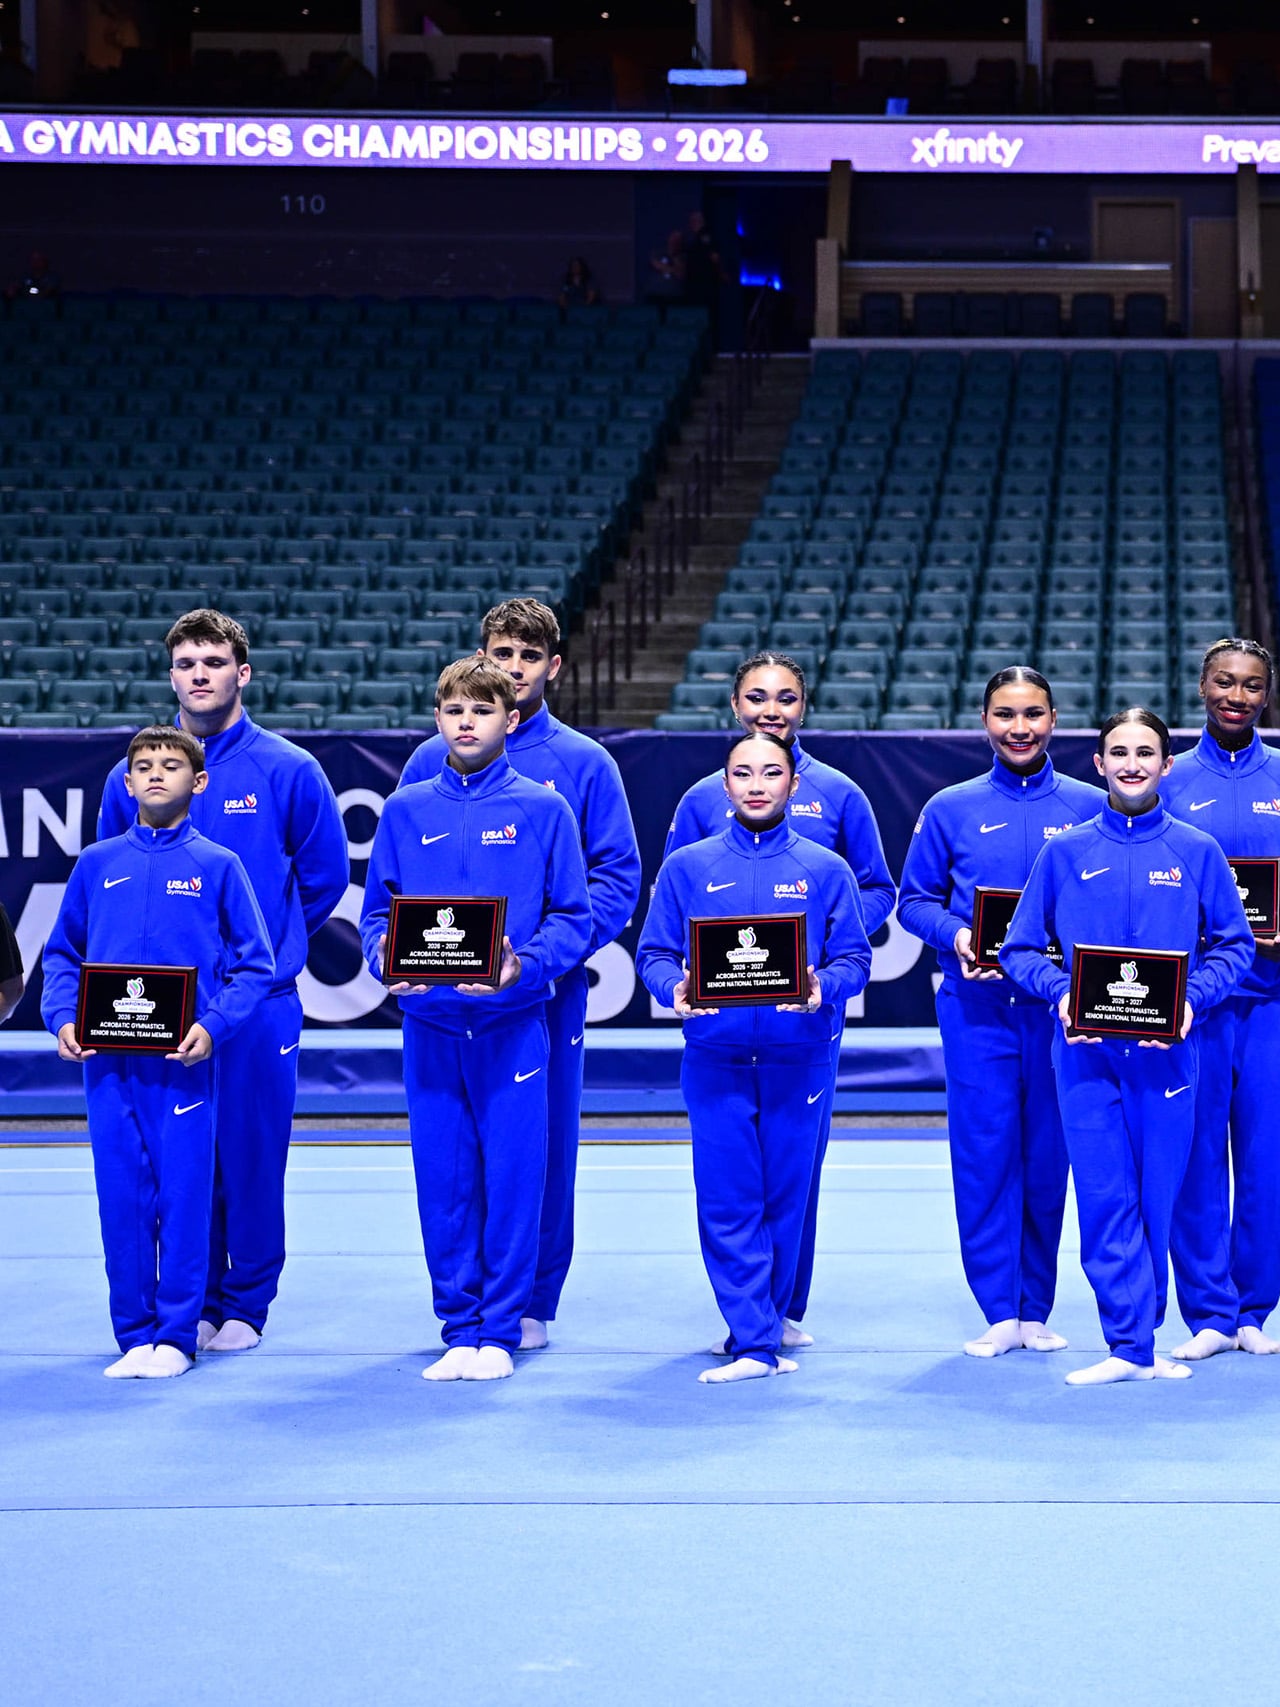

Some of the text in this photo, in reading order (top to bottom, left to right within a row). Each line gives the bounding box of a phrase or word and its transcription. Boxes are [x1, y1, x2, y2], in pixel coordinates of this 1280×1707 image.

[23, 119, 293, 157] GYMNASTICS
[302, 123, 644, 162] CHAMPIONSHIPS
[675, 128, 769, 163] 2026
[911, 128, 1023, 168] xfinity
[280, 194, 326, 215] 110
[224, 800, 244, 808] USA
[791, 804, 810, 812] USA
[482, 831, 503, 839] USA
[1149, 871, 1170, 880] USA
[167, 880, 189, 889] USA
[774, 884, 795, 892] USA
[1125, 1007, 1158, 1015] GYMNASTICS
